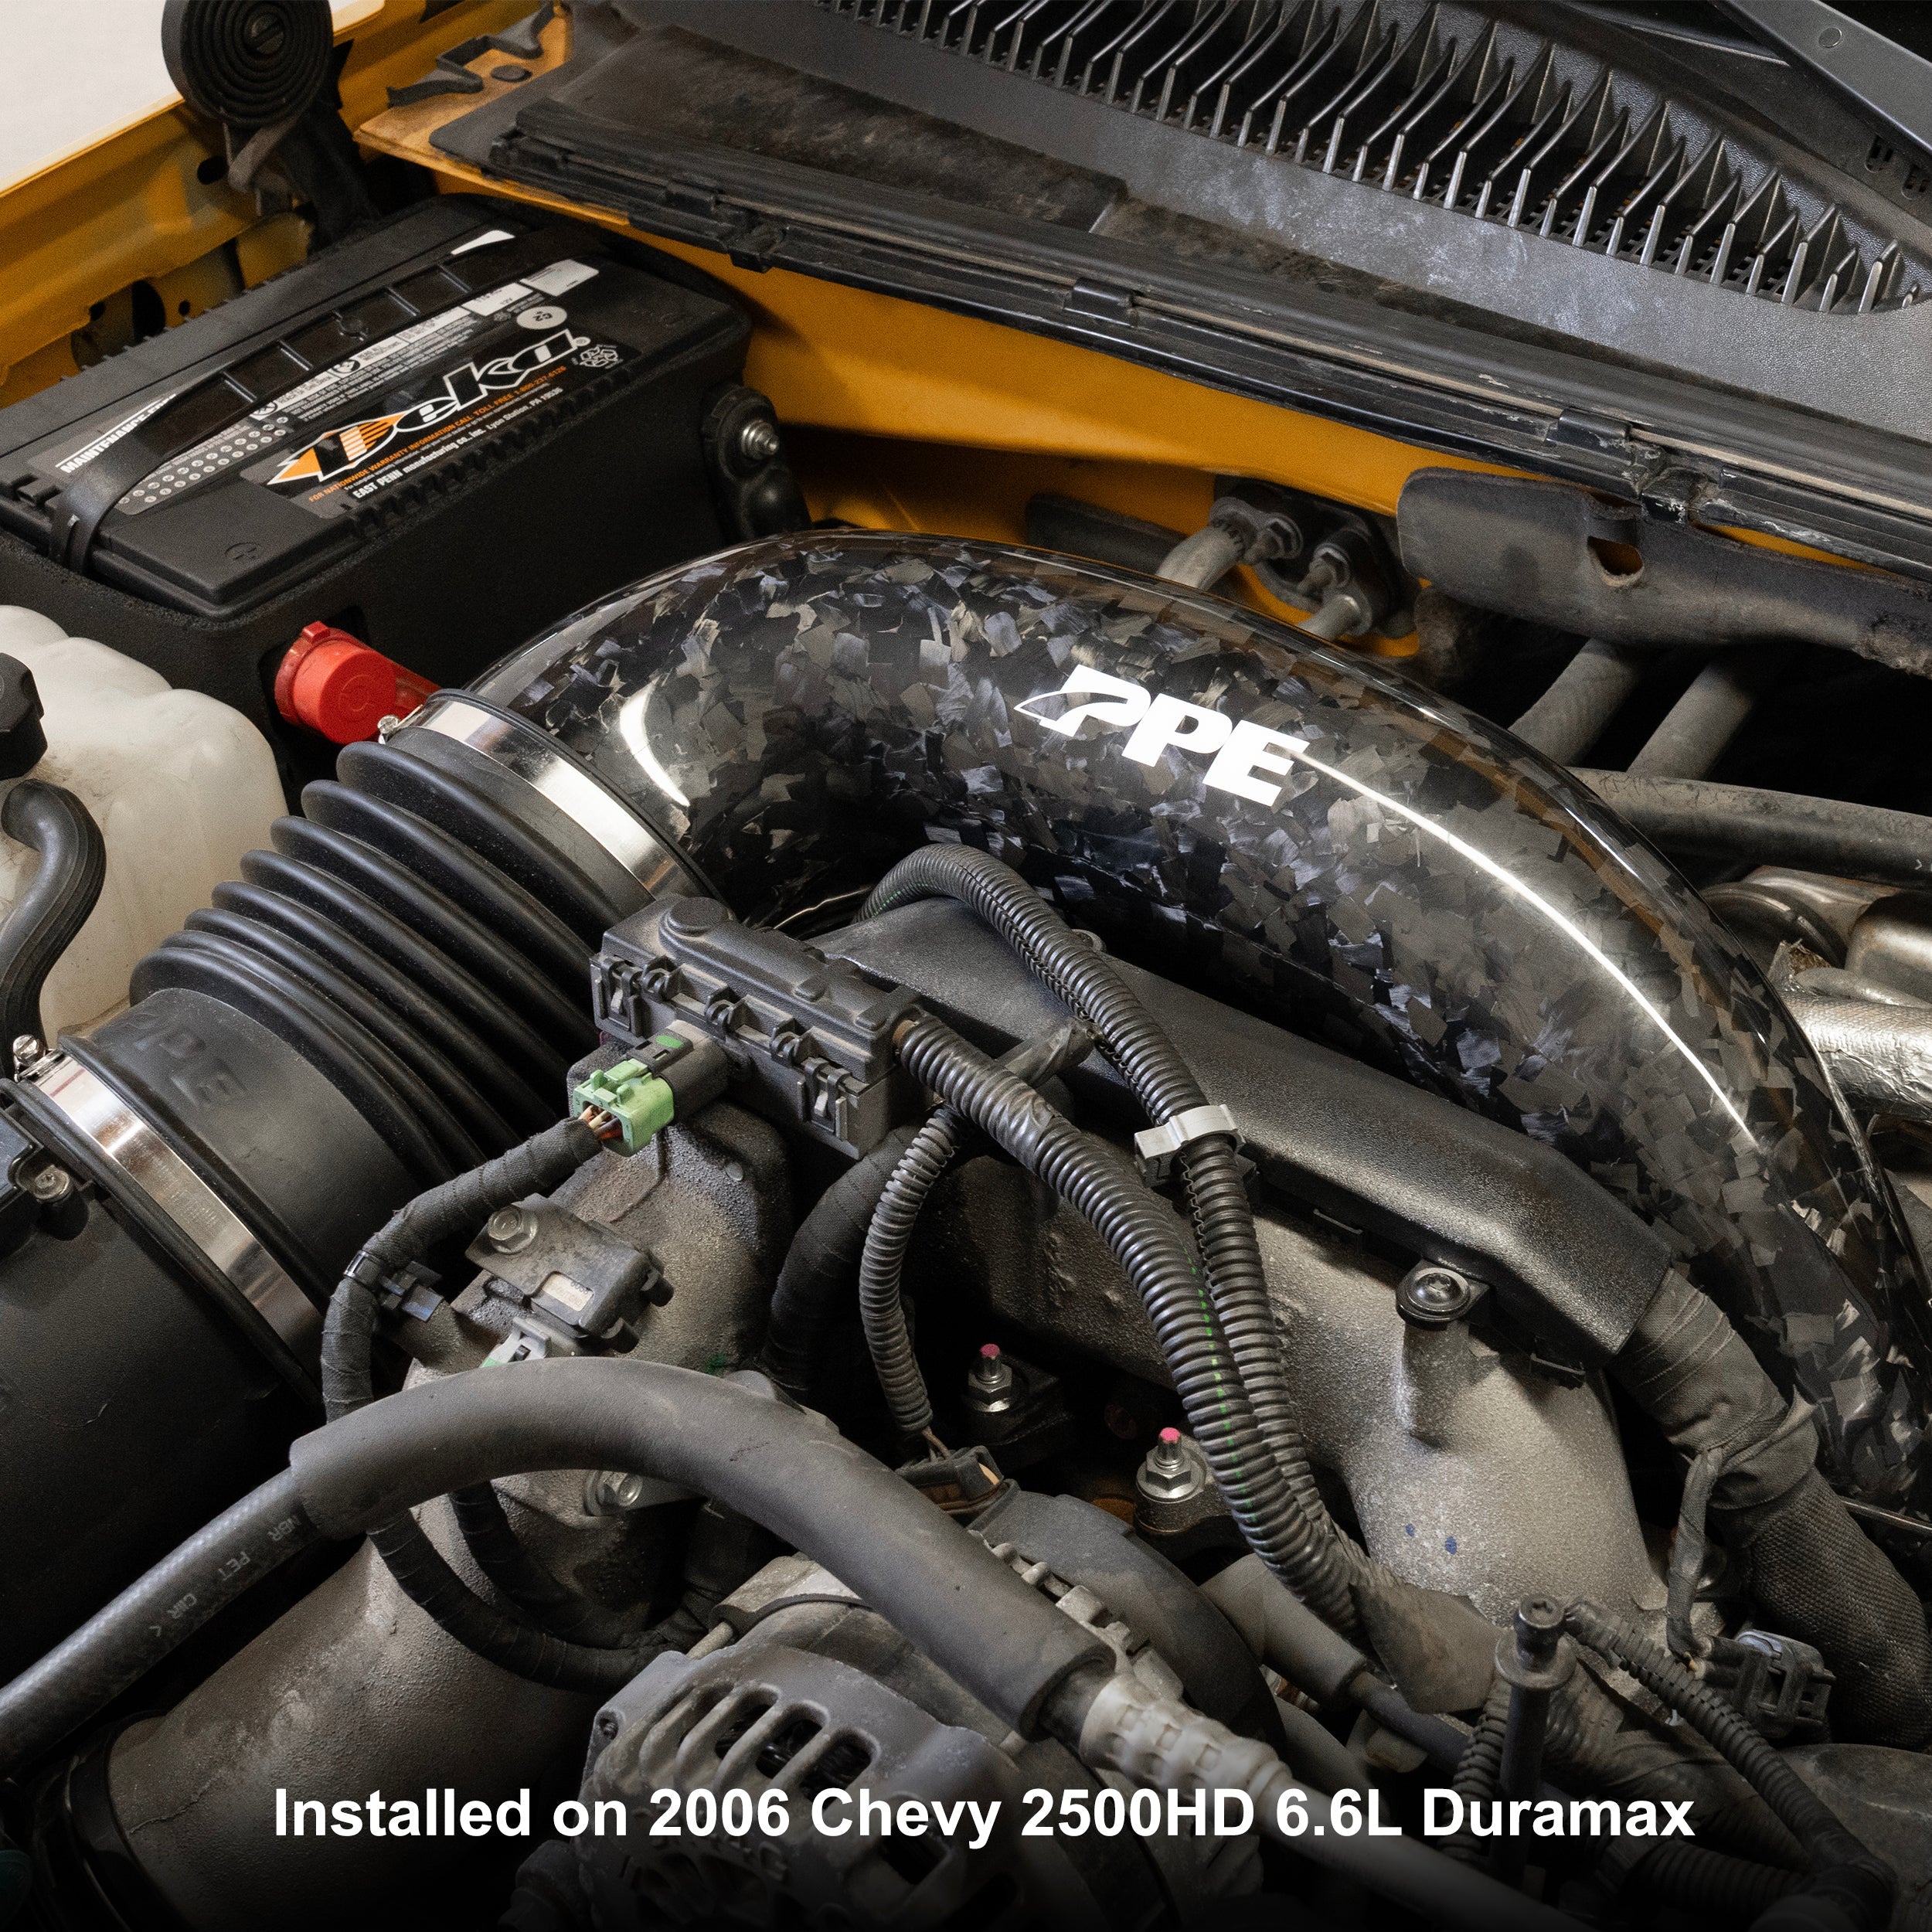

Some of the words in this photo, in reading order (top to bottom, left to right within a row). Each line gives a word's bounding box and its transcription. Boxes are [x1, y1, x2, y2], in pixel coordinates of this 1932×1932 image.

[309, 490, 324, 502] FOR
[323, 468, 370, 498] NATIONWIDE
[368, 447, 409, 471] WARRANTY
[407, 423, 456, 451] INFORMATION
[473, 403, 495, 416] TOLL
[494, 393, 515, 406] FREE
[352, 482, 378, 498] EAST
[376, 469, 403, 486] PENN
[403, 442, 459, 473] manufacturing
[485, 418, 505, 430] Lyon
[529, 398, 543, 406] PA
[1013, 664, 1311, 807] PPE
[217, 1550, 251, 1581] PET
